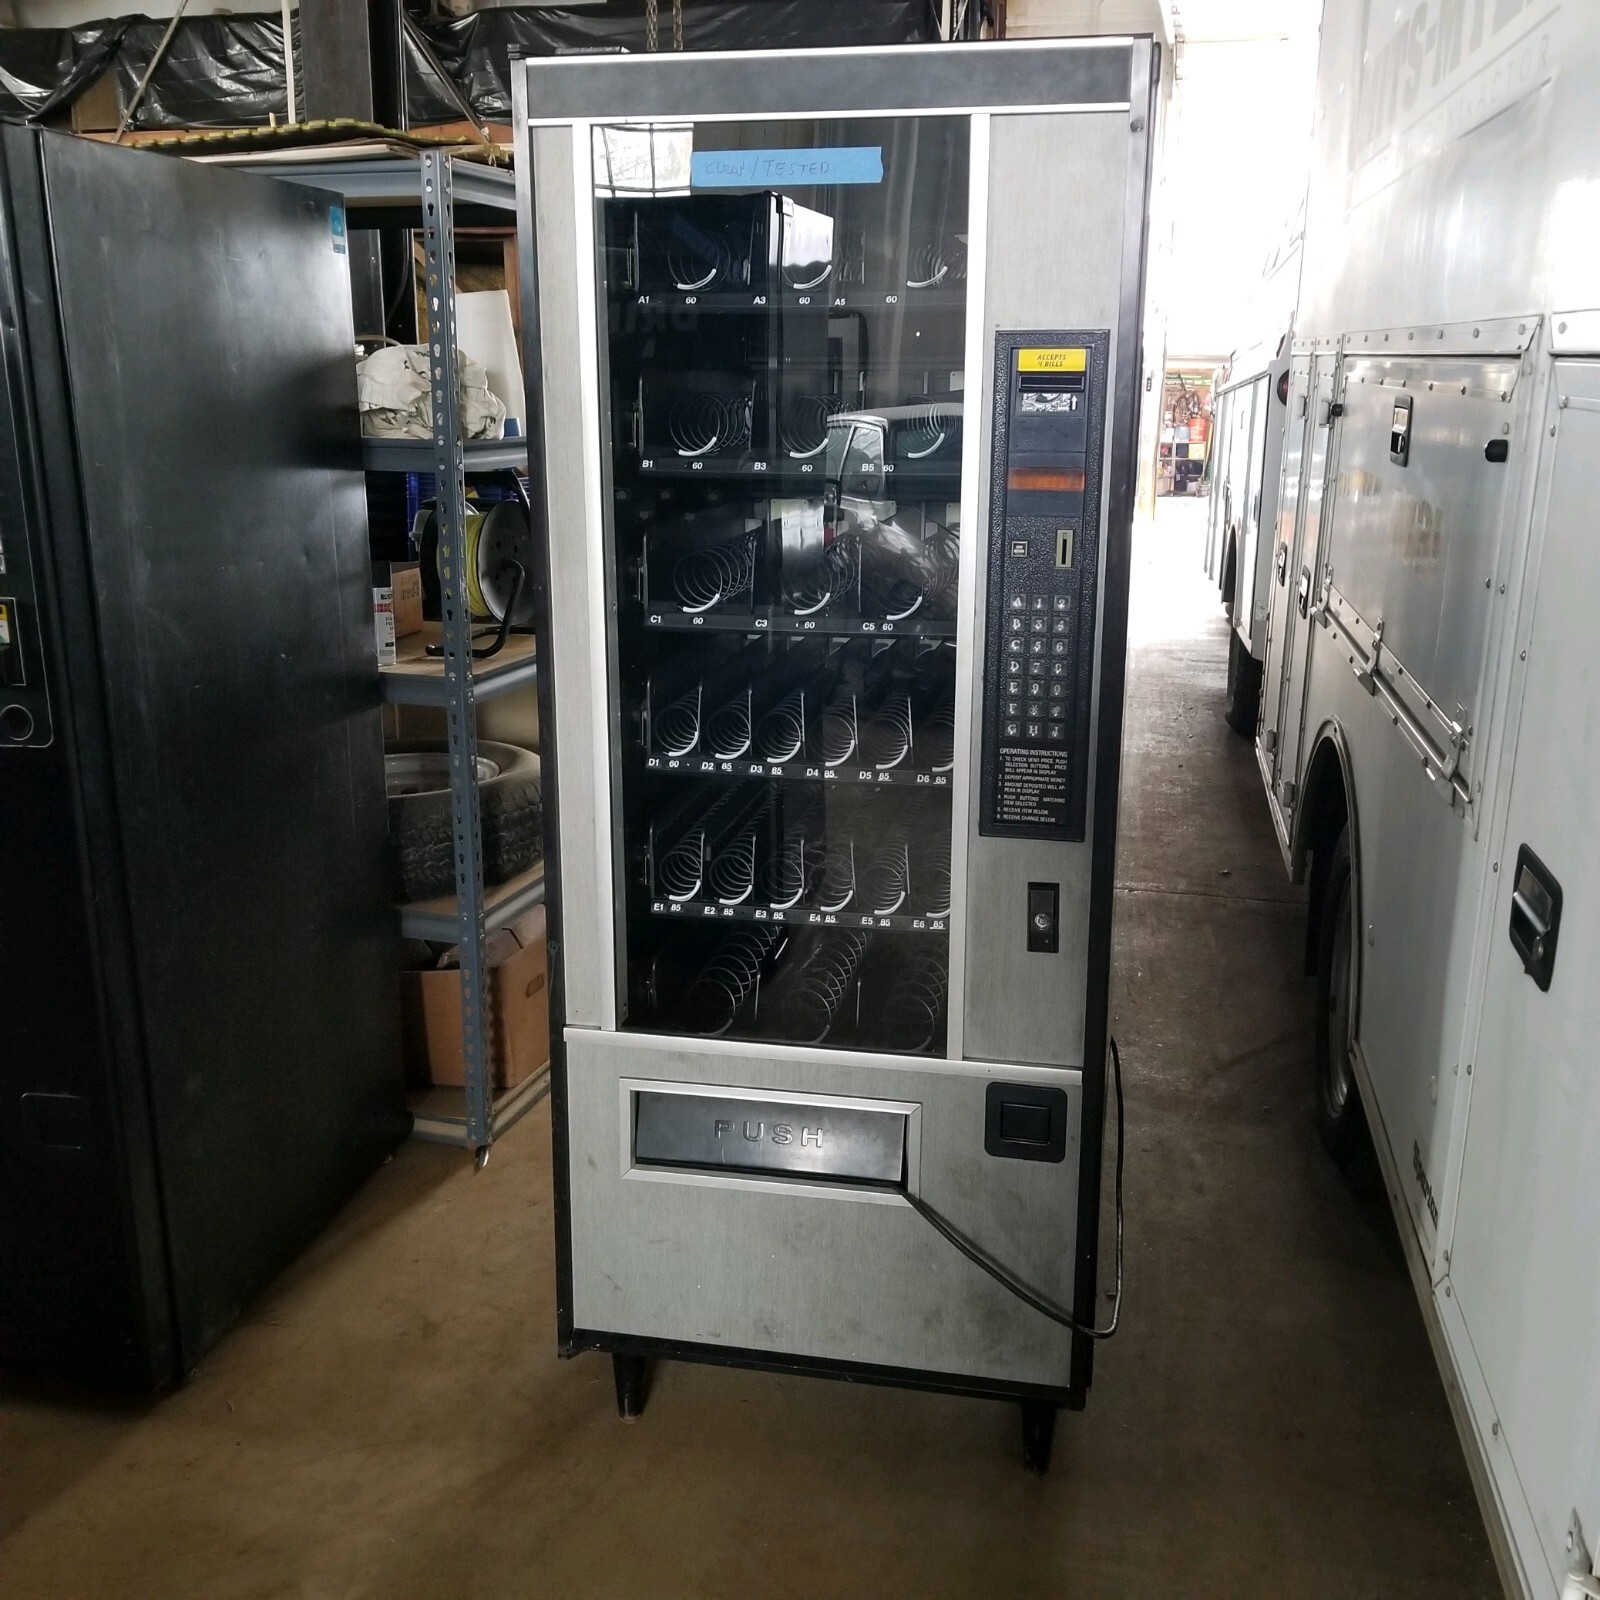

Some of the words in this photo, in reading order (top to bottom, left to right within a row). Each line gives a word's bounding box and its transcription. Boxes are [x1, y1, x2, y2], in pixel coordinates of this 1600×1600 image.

[638, 296, 650, 304] A1
[753, 296, 766, 304] A3
[834, 298, 845, 306] A5
[642, 460, 654, 468] B1
[692, 462, 703, 470] 60
[754, 462, 766, 470] B3
[802, 464, 812, 472] 60
[883, 464, 894, 472] 60
[650, 615, 662, 623] C1
[692, 617, 704, 625] 60
[755, 619, 768, 628] C3
[648, 758, 659, 766] D1
[702, 762, 714, 770] D2
[750, 765, 762, 773] D3
[806, 768, 819, 776] D4
[860, 771, 872, 780] D5
[654, 903, 664, 911] E1
[704, 906, 715, 915] E2
[755, 910, 767, 918] E3
[810, 914, 821, 922] E4
[862, 916, 873, 925] E5
[913, 920, 925, 928] E6
[714, 1120, 823, 1148] PUSH
